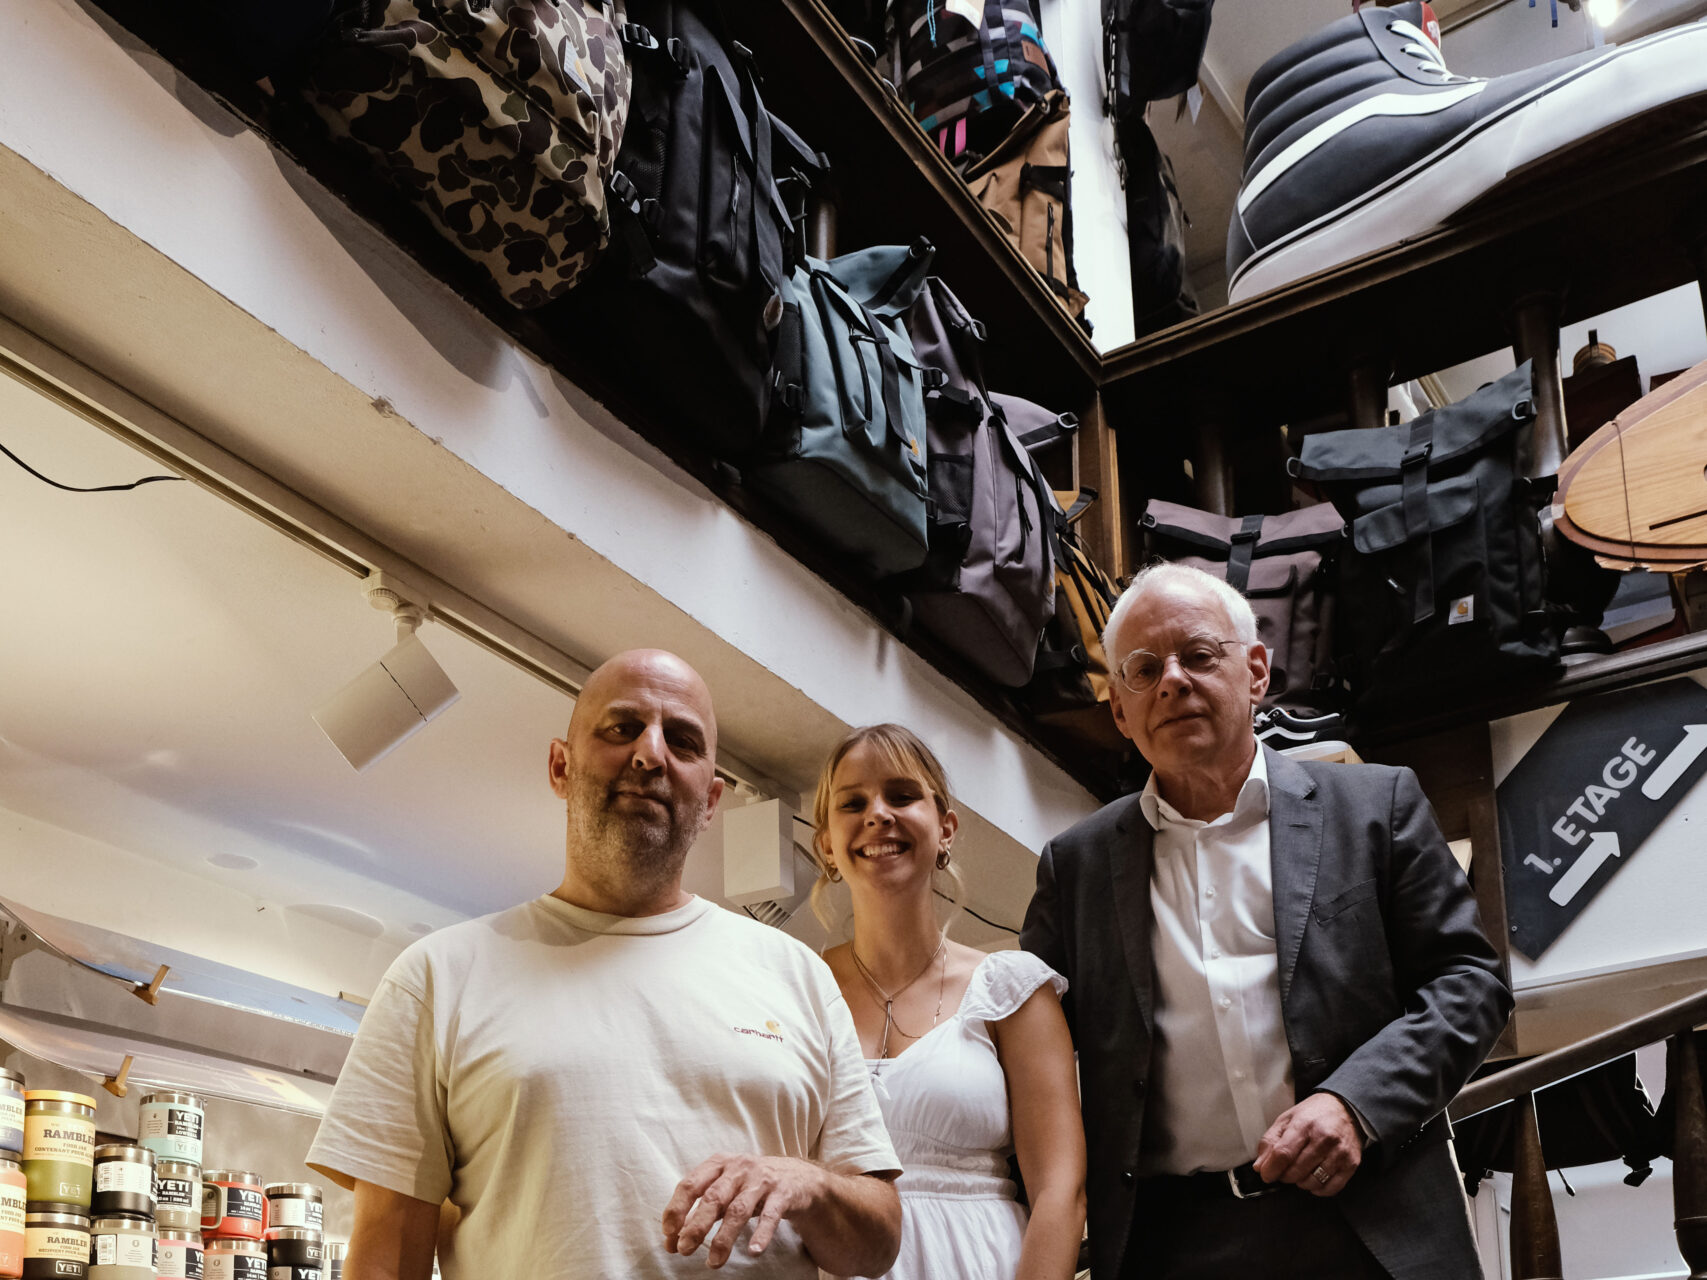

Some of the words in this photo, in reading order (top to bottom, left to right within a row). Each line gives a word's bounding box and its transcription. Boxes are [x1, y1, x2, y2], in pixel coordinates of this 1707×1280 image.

[1523, 852, 1562, 875] 1.
[1551, 736, 1657, 846] ETAGE
[175, 1111, 199, 1124] YETI
[157, 1180, 190, 1193] YETI
[58, 1263, 81, 1274] YETI
